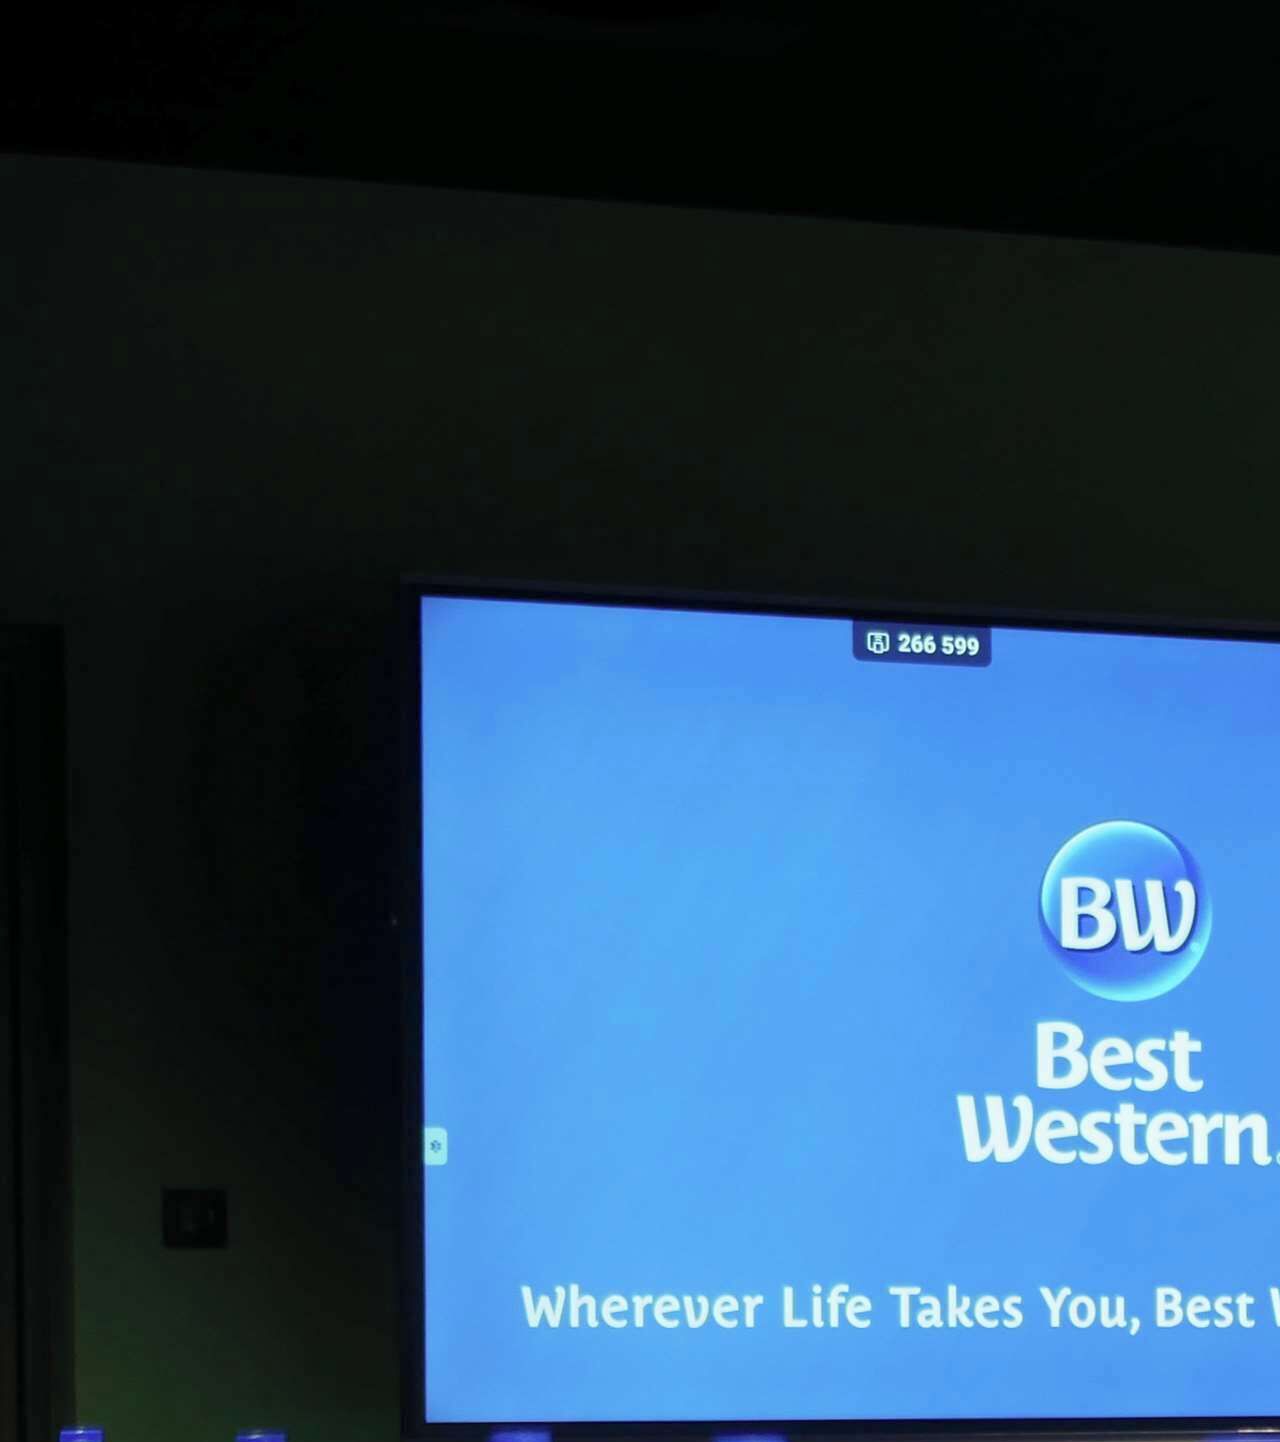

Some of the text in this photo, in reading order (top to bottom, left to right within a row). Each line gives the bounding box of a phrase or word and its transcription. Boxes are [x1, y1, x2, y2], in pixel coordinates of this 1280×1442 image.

[898, 633, 980, 656] 266 599
[1060, 876, 1197, 953] BW
[1035, 1021, 1204, 1093] Best
[521, 1283, 764, 1329] Wherever
[783, 1283, 872, 1329] Life
[888, 1284, 1024, 1329] Takes
[1039, 1286, 1141, 1336] You,
[1155, 1286, 1256, 1328] Best
